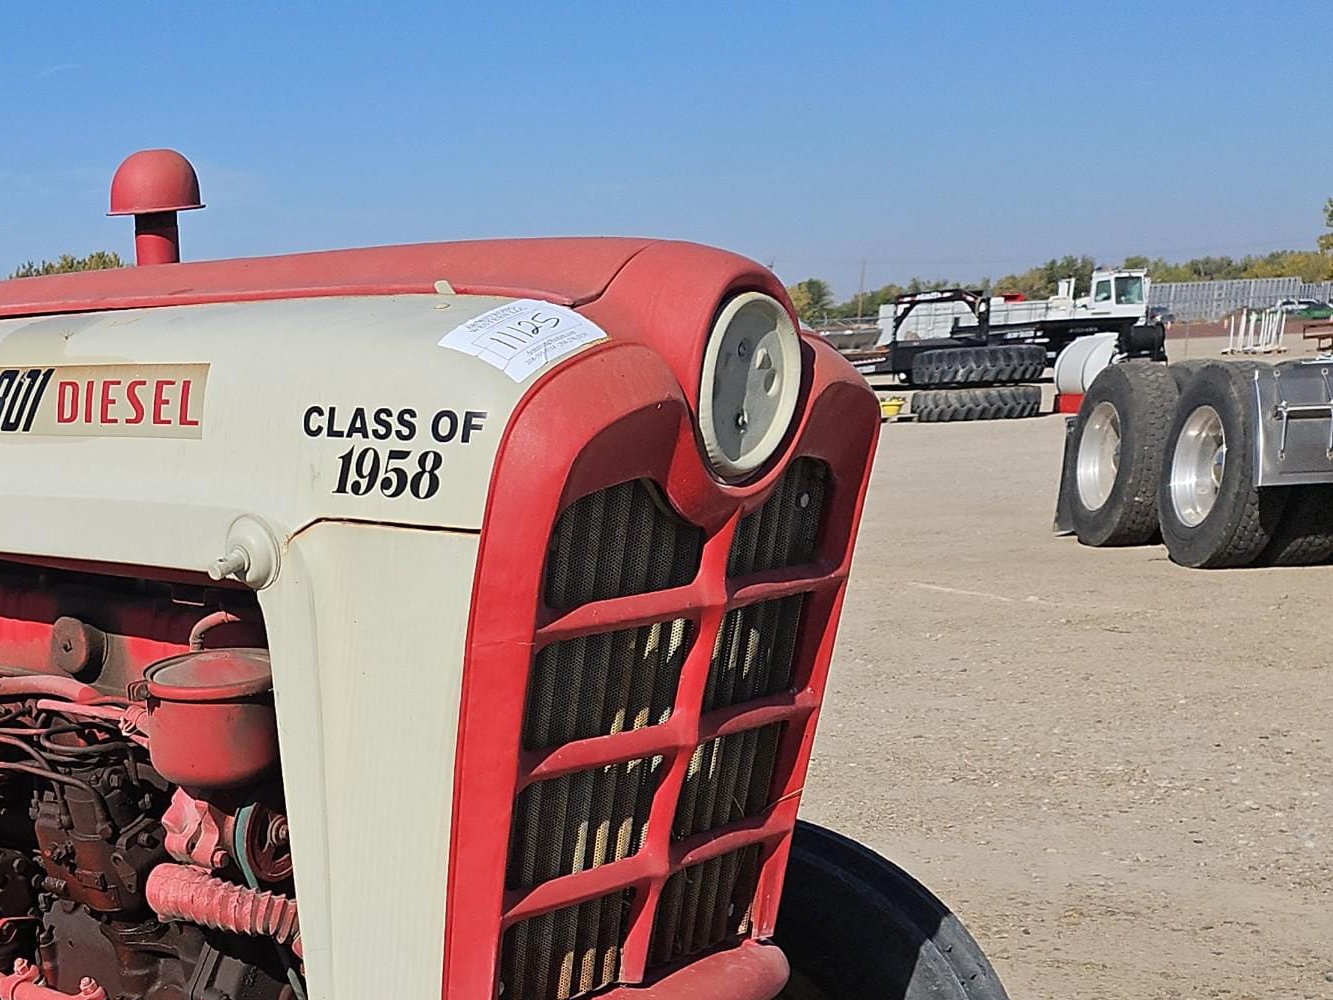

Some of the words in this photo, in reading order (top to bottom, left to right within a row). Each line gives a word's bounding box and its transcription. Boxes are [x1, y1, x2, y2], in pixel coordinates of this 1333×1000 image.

[489, 312, 560, 350] 11125
[56, 378, 201, 427] DIESEL
[303, 405, 418, 441] CLASS
[430, 409, 489, 444] OF
[331, 444, 444, 500] 1958
